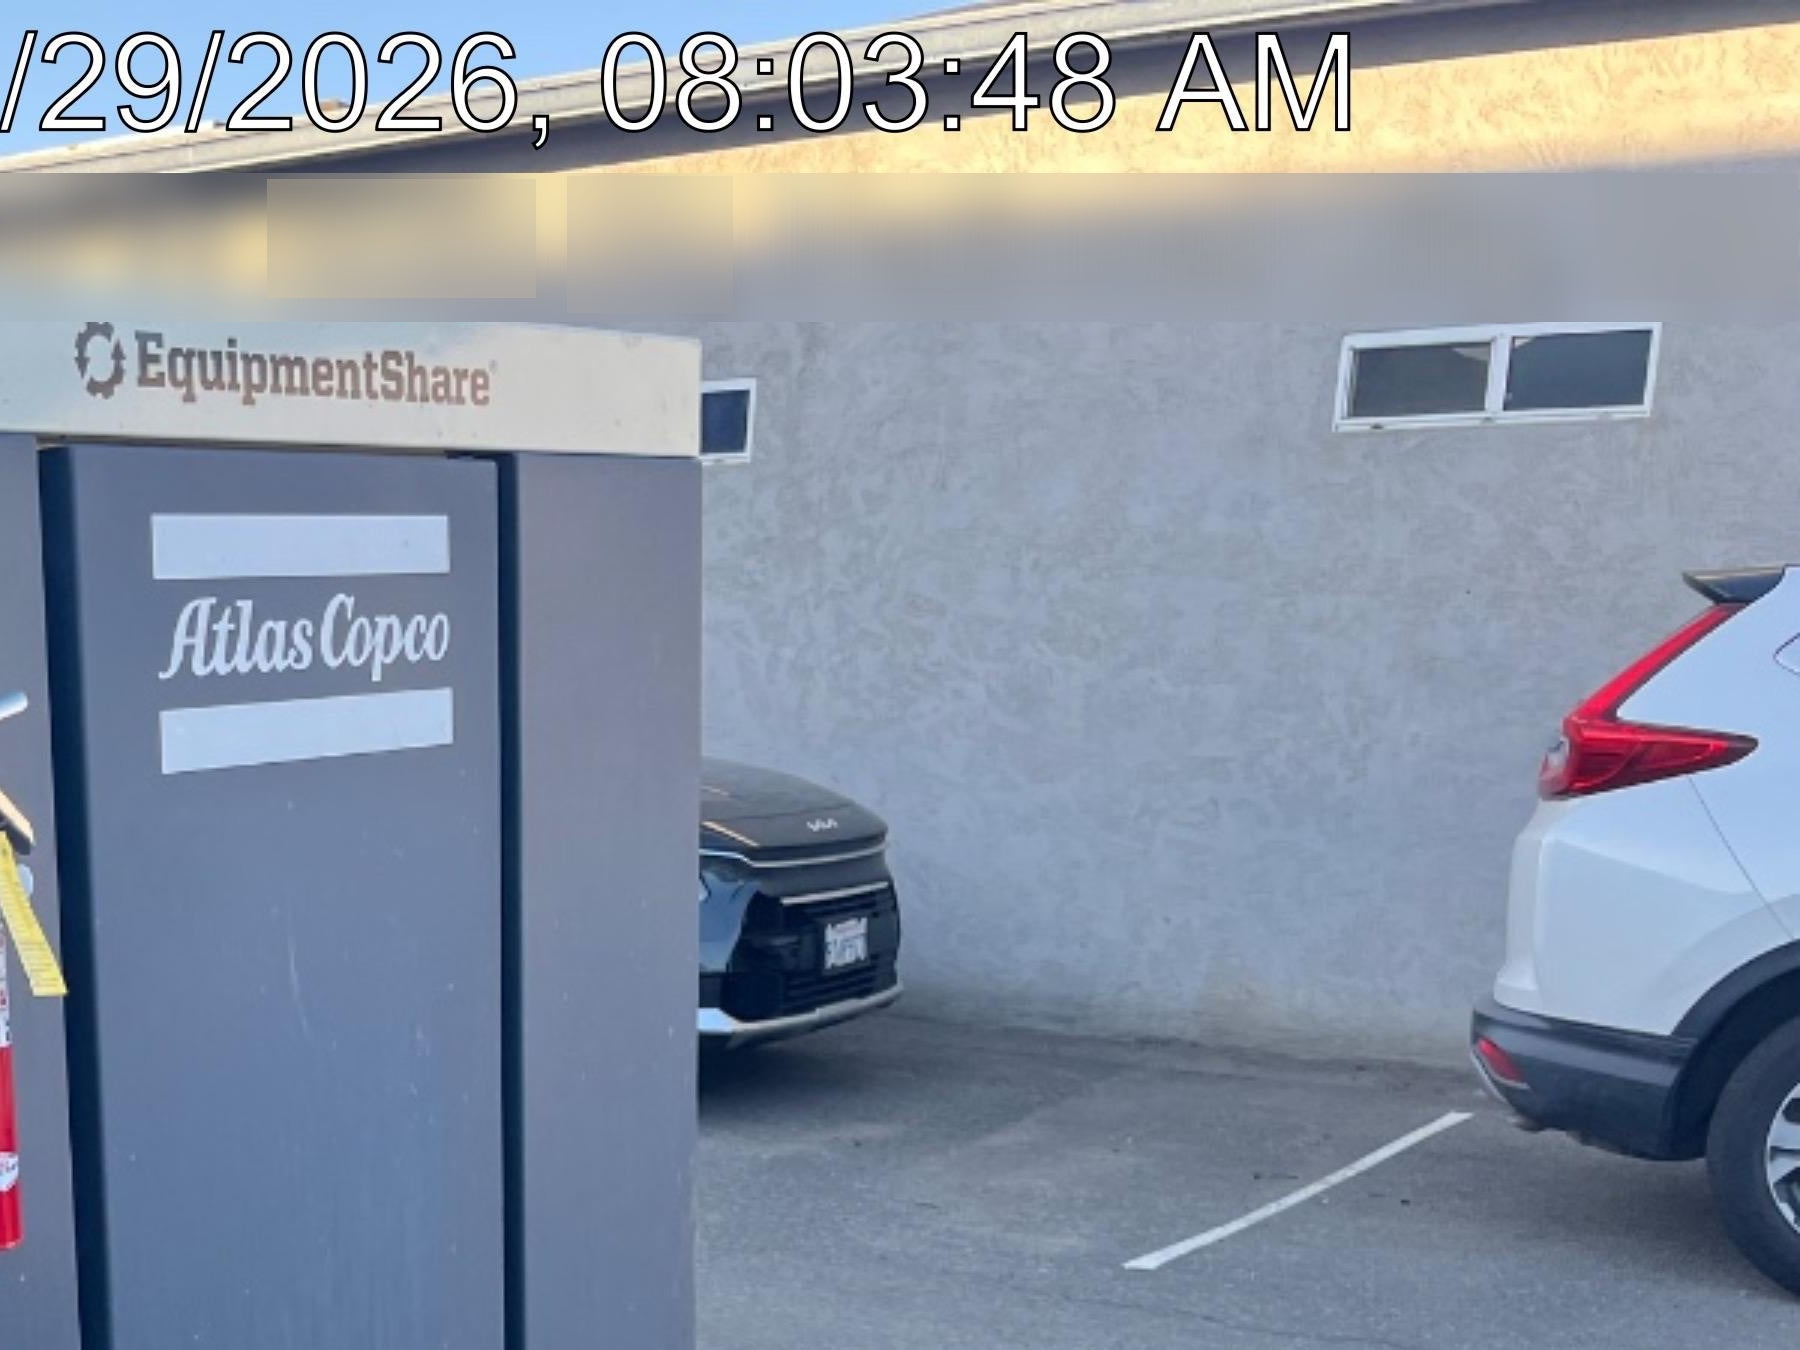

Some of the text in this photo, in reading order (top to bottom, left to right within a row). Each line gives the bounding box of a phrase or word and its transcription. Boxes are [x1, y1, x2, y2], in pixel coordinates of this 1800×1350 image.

[134, 330, 491, 406] EquipmentShare
[158, 593, 450, 682] Atlas Copco
